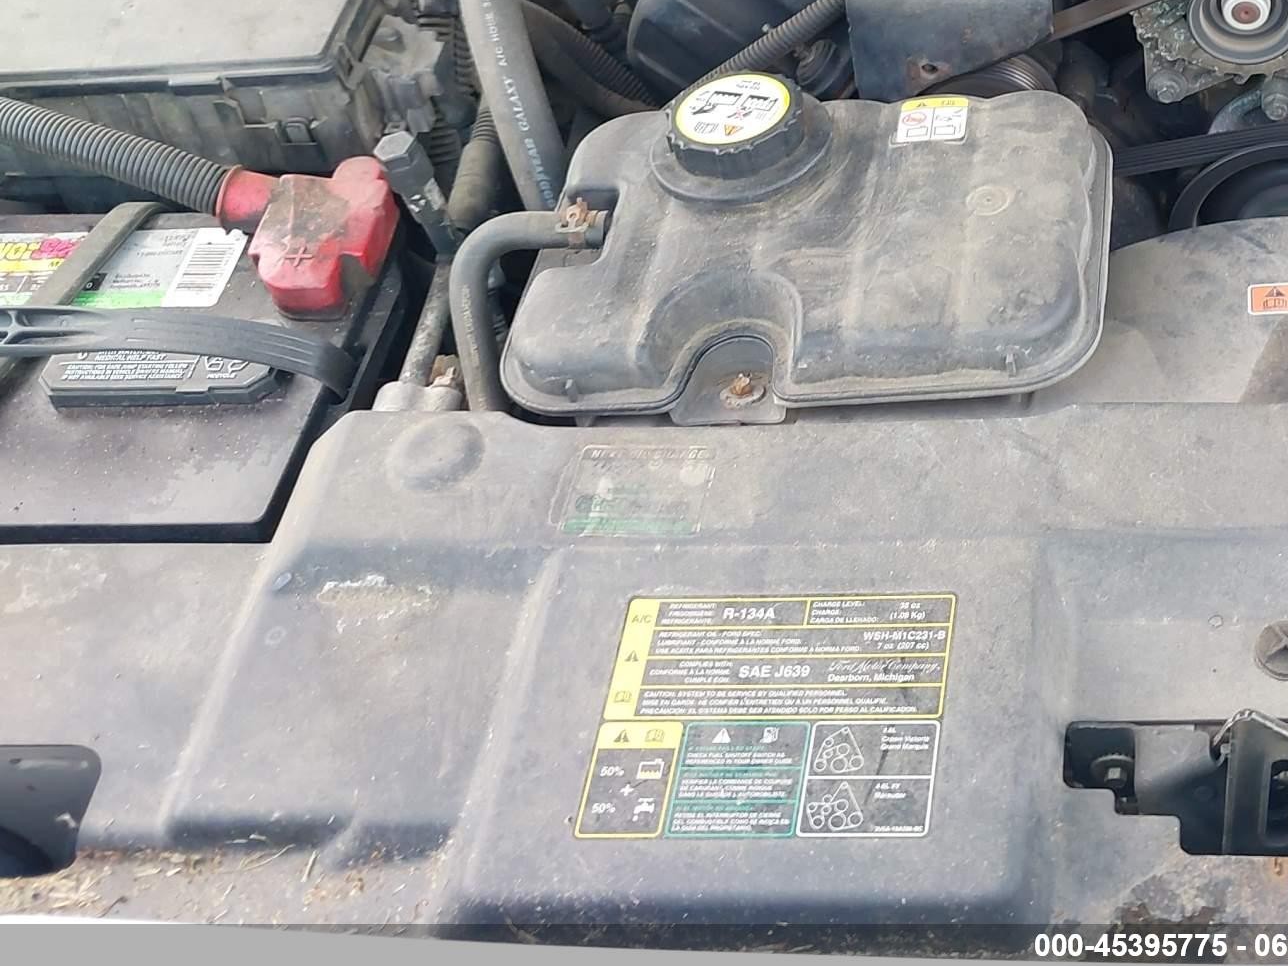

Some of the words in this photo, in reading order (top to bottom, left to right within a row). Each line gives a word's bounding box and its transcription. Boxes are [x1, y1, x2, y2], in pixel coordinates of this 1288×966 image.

[722, 607, 776, 620] R-134A
[738, 665, 772, 678] SAE
[774, 664, 811, 678] J639
[828, 674, 872, 682] Dearborn,
[874, 674, 915, 683] Michigan
[600, 766, 625, 777] 50%
[592, 802, 616, 814] 50%
